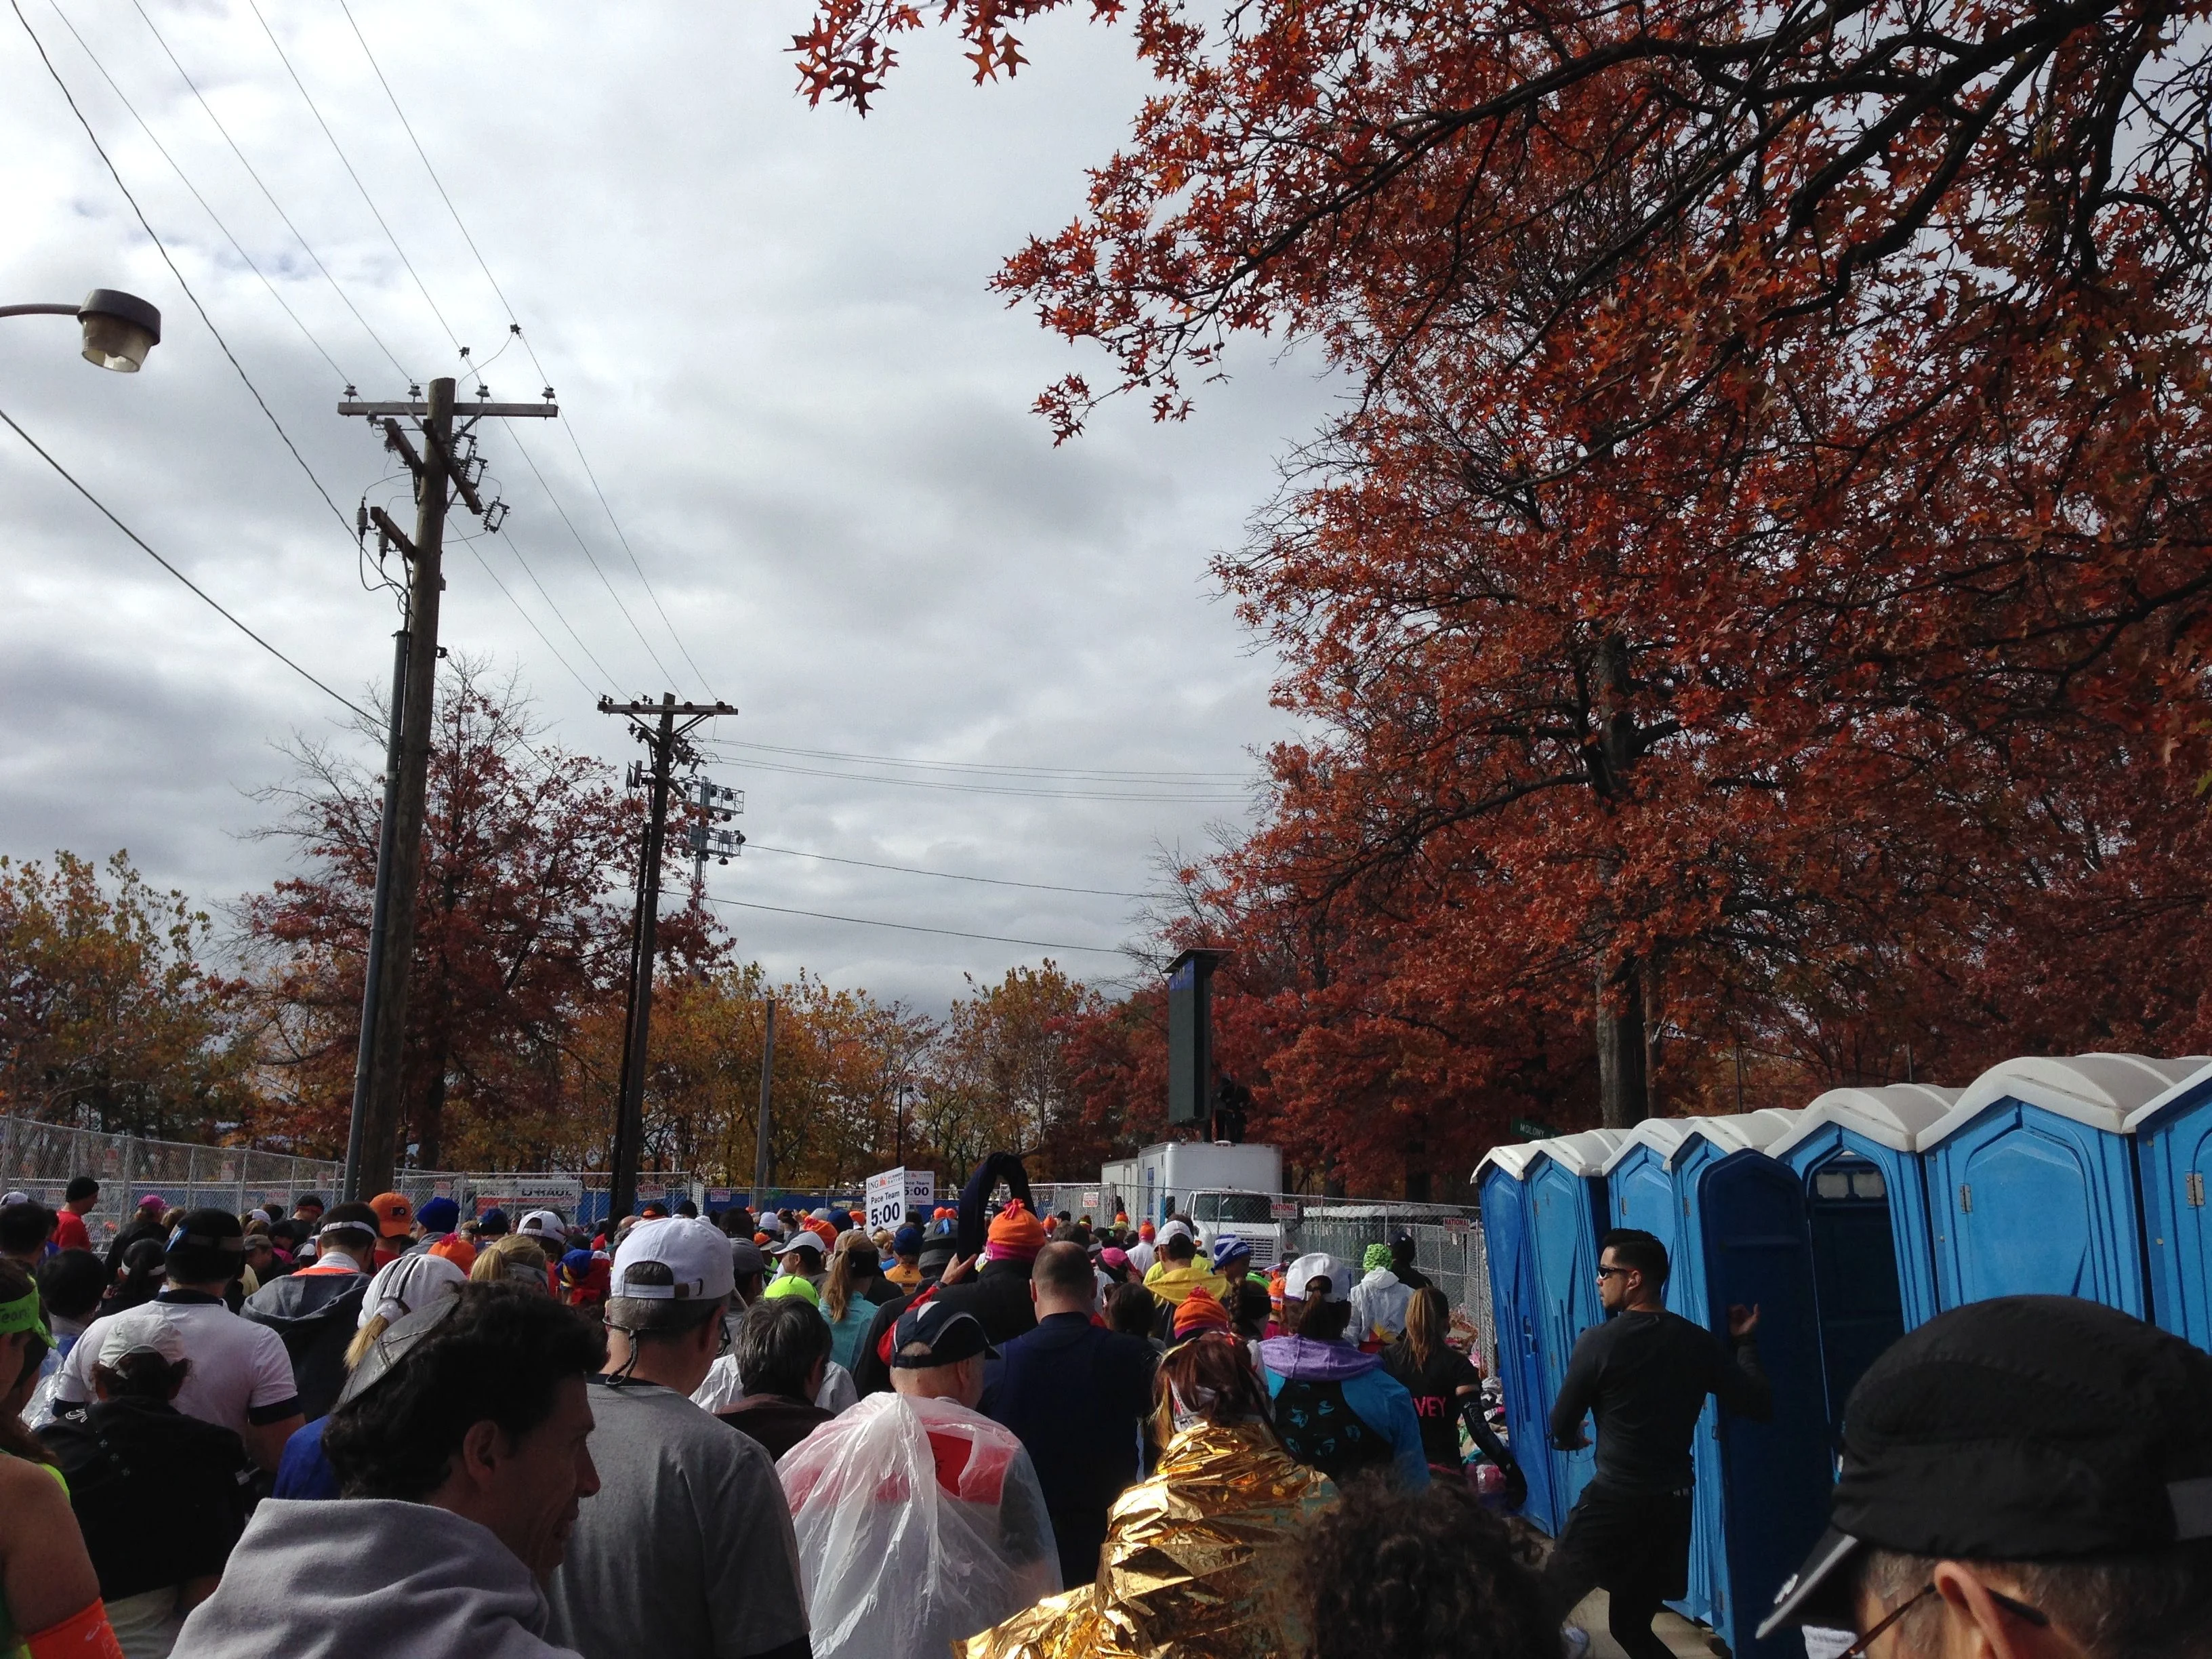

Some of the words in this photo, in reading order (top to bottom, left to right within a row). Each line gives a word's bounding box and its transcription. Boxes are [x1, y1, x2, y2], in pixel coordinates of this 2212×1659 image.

[638, 1184, 664, 1193] NATIONAL
[868, 1180, 879, 1191] ING
[871, 1195, 884, 1205] Pace
[884, 1191, 900, 1201] Team
[1271, 1204, 1296, 1212] NATIONAL
[871, 1202, 900, 1227] 5:00
[1444, 1218, 1469, 1227] NATIONAL
